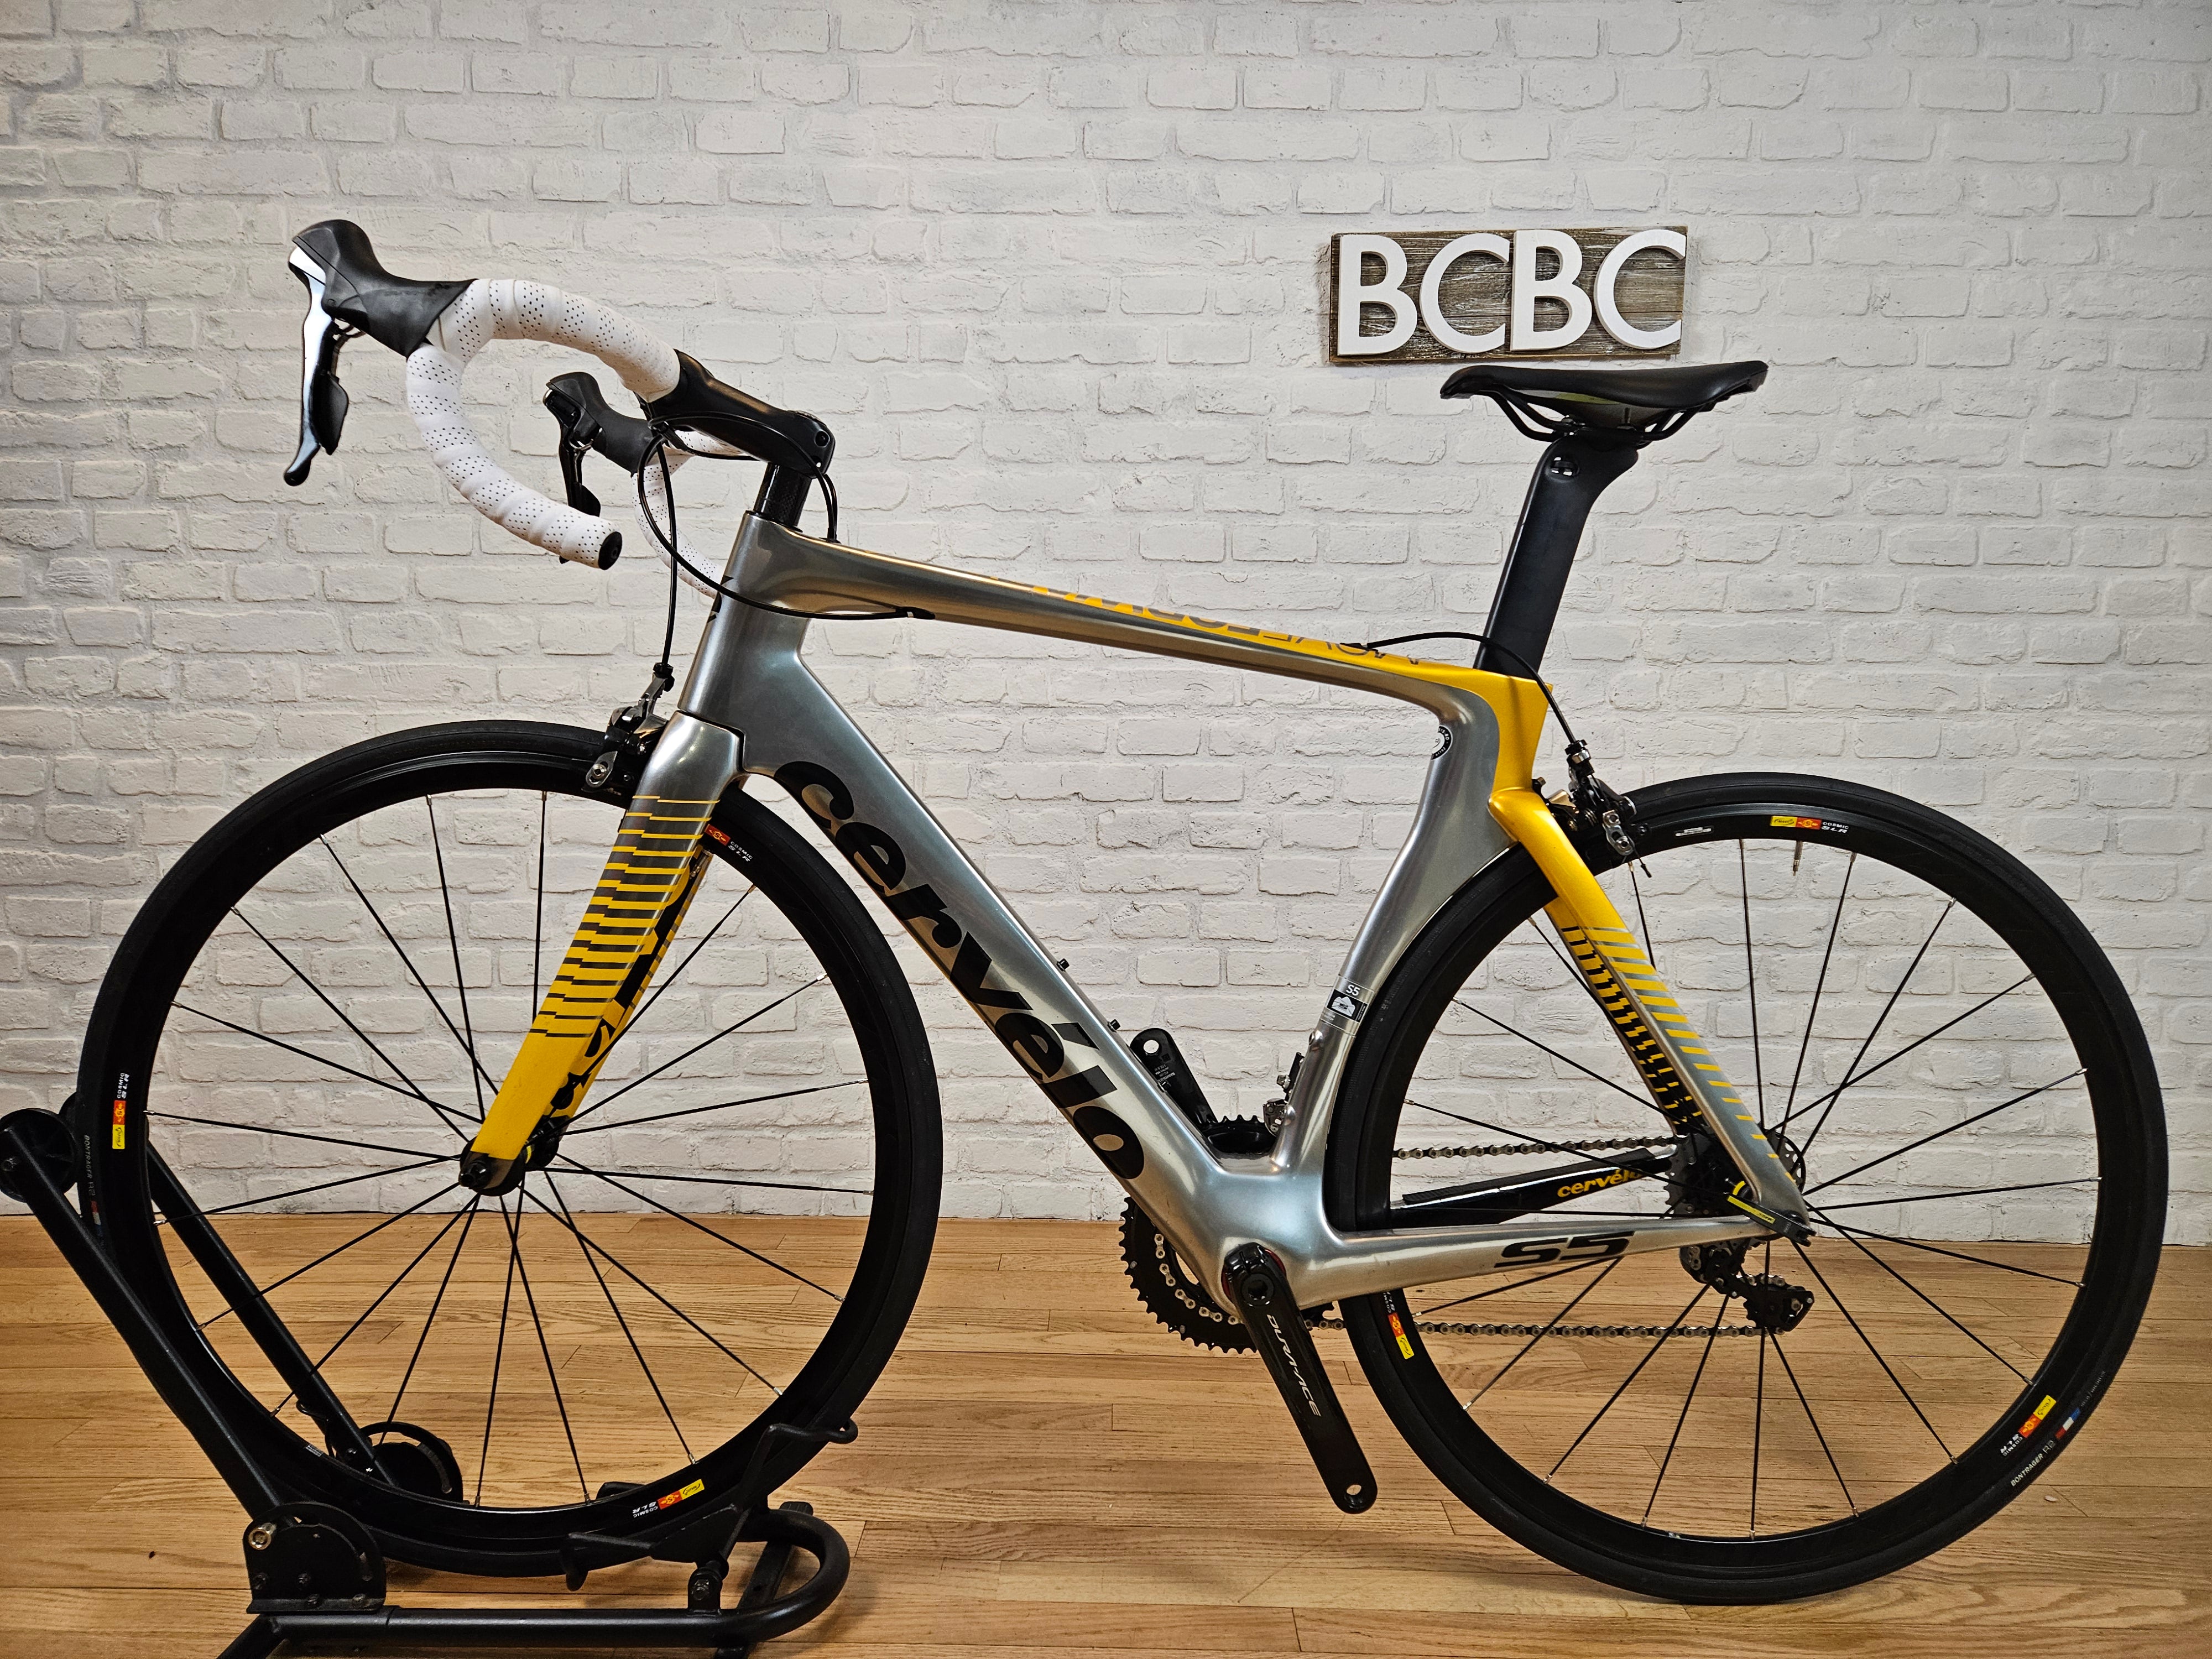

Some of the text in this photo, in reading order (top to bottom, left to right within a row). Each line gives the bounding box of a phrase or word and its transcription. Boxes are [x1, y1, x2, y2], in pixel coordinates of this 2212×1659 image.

[1337, 229, 1686, 356] BCBC
[728, 844, 751, 863] SLR
[730, 841, 753, 859] COSMIC
[774, 760, 1145, 1180] cervélo
[1346, 984, 1360, 996] S5
[84, 1135, 92, 1180] BONTRAGER
[1494, 1231, 1635, 1268] S5
[1267, 1313, 1322, 1417] DURA-ACE
[2011, 1453, 2043, 1486] BONTRAGER
[632, 1501, 656, 1514] SLR
[633, 1506, 658, 1518] COSMIC
